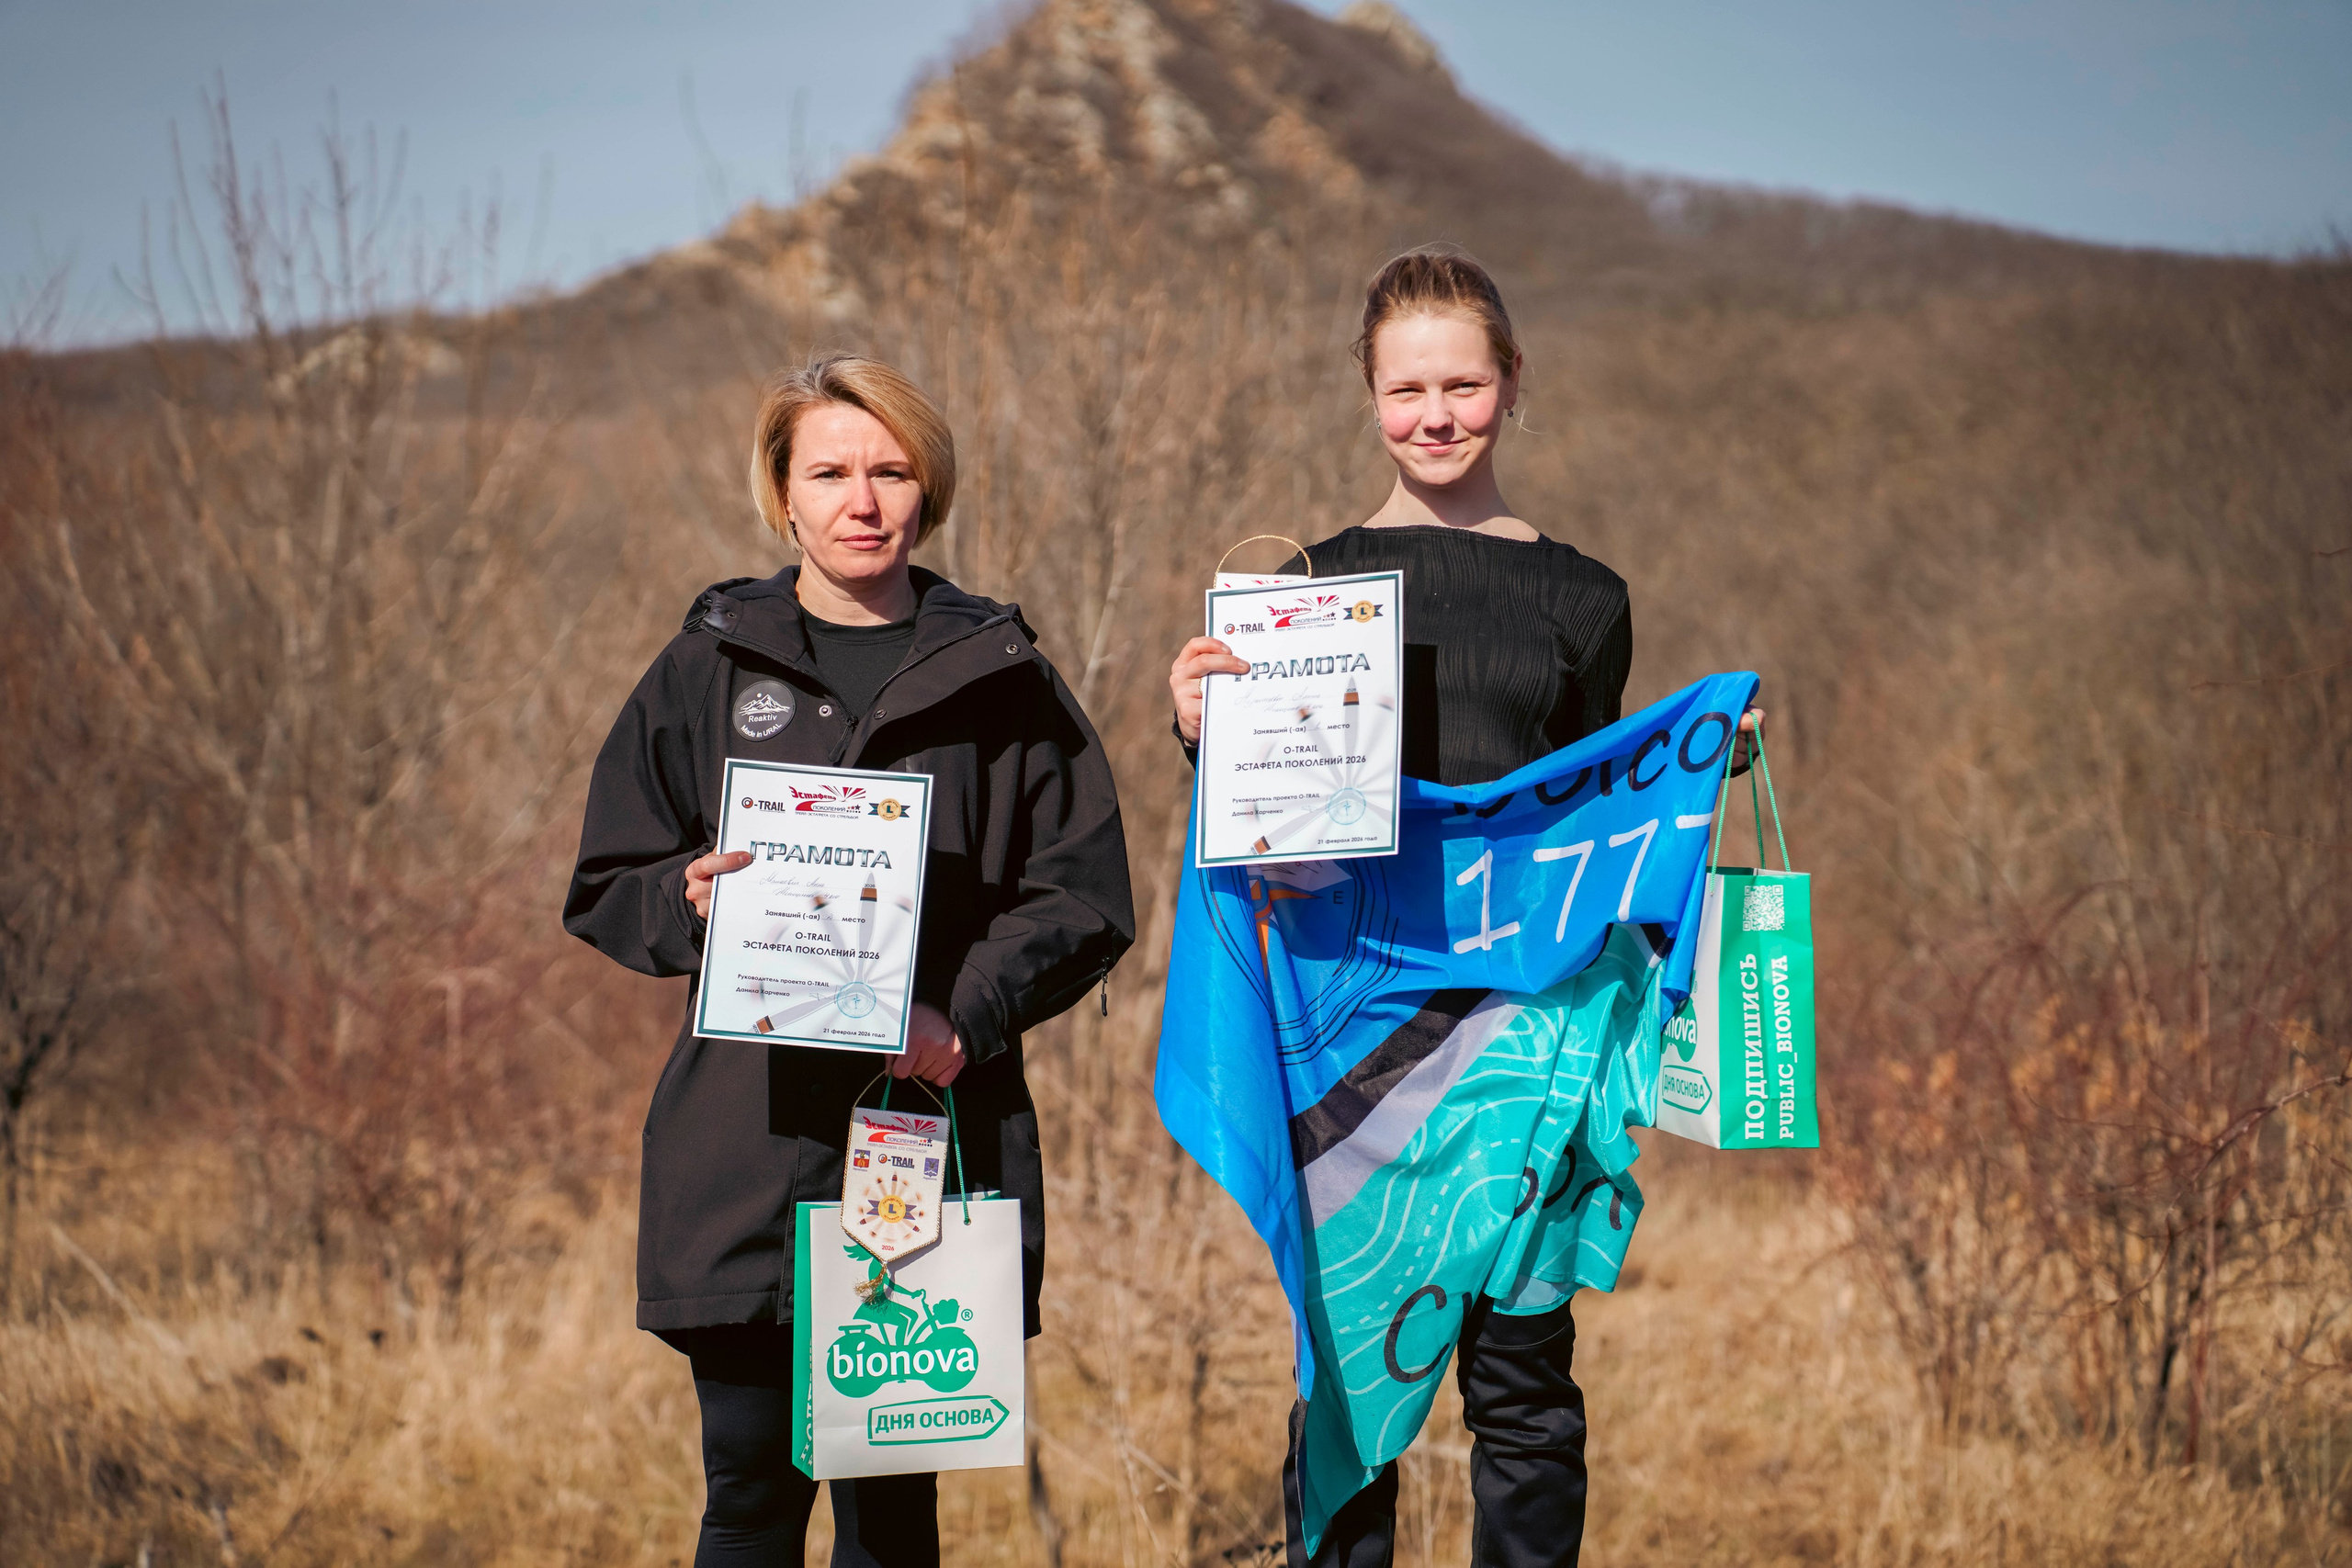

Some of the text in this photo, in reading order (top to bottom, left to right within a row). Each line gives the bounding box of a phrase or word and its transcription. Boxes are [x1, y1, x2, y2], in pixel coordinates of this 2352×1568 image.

[1235, 653, 1371, 682] РАМОТА
[741, 724, 755, 738] Made
[763, 722, 782, 737] URAL
[1283, 745, 1318, 754] O-TRAIL
[1235, 755, 1366, 772] ЭСТАФЕТА ПОКОЛЕНИЙ 2026
[788, 785, 837, 800] Эстафета
[812, 805, 846, 813] ПОКОЛЕНИЙ
[750, 840, 892, 869] ГРАМОТА
[764, 909, 801, 919] Занявший
[796, 931, 831, 942] O-TRAIL
[742, 941, 880, 960] ЭСТАФЕТА ПОКОЛЕНИЙ 2026
[737, 974, 779, 983] Руководитель
[807, 979, 830, 987] O-TRAIL
[760, 988, 790, 997] Харченко
[1663, 1016, 1697, 1044] nova
[1740, 953, 1768, 1140] ПОДПИШИСЬ
[1664, 1074, 1705, 1100] ДНЯ ОСНОВА
[832, 1341, 976, 1379] bionova
[875, 1407, 994, 1433] ДНЯ ОСНОВА
